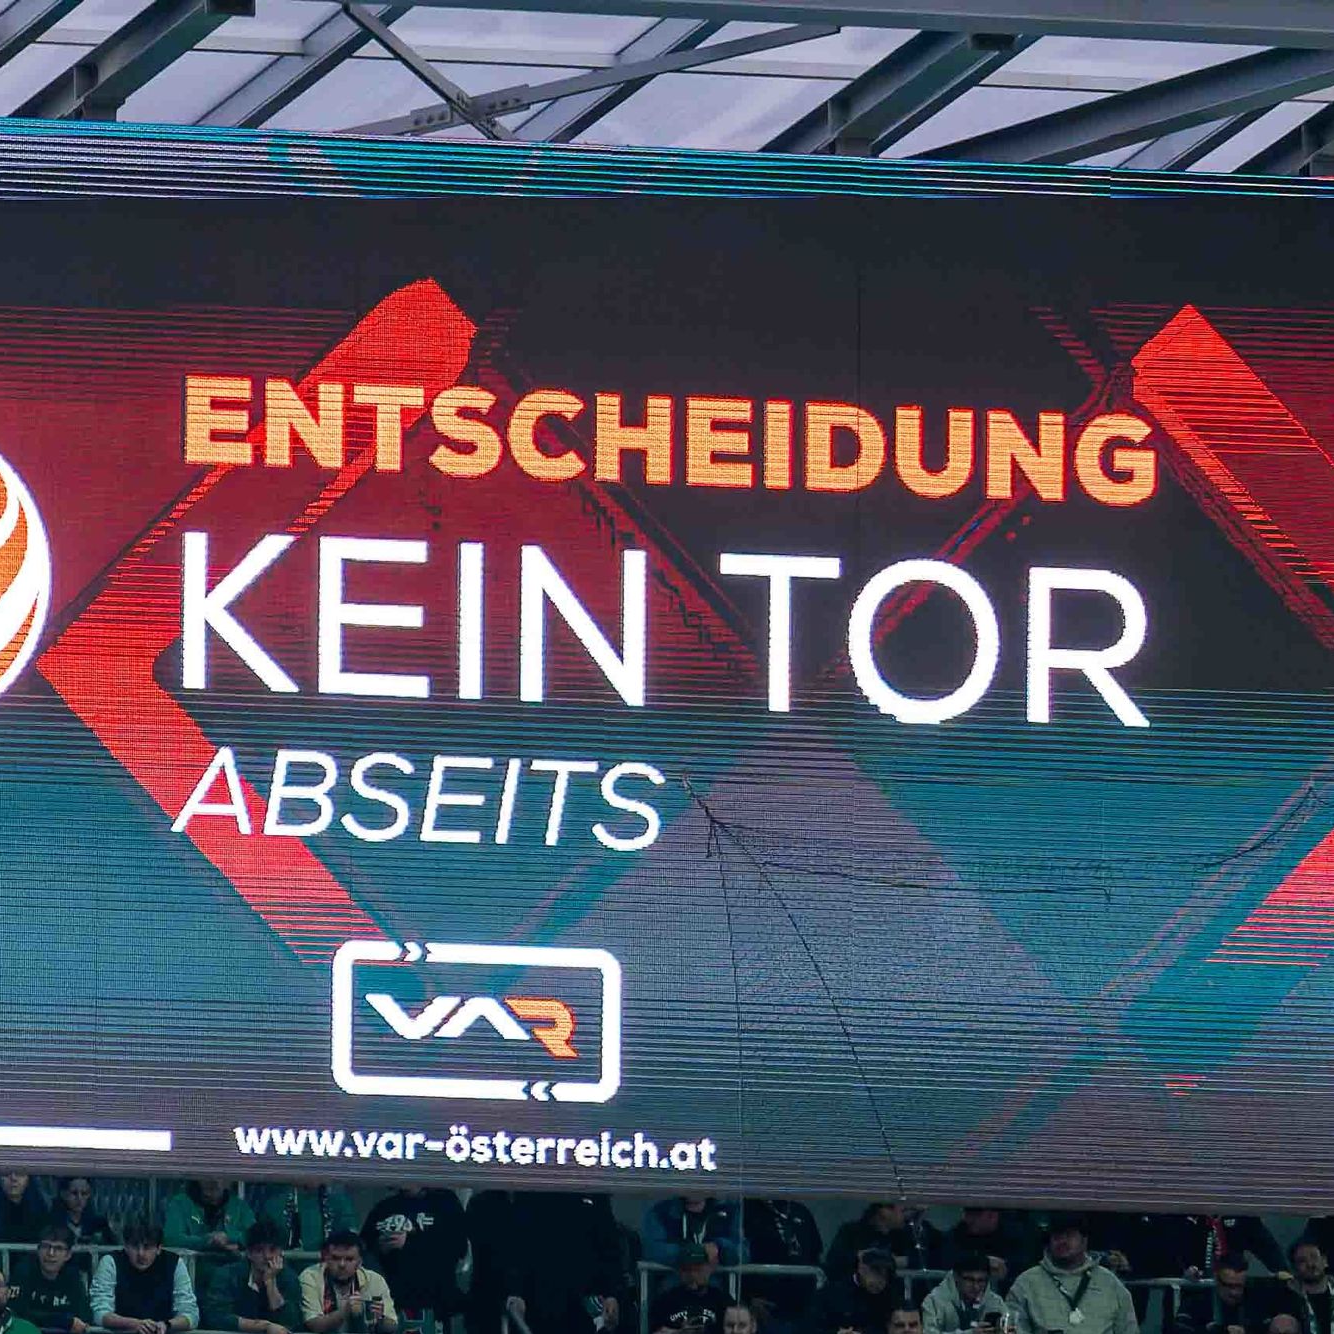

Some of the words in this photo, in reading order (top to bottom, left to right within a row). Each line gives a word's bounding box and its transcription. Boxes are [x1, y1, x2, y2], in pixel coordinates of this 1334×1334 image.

[183, 376, 1157, 506] ENTSCHEIDUNG
[180, 530, 648, 708] KEIN
[717, 552, 1152, 729] TOR
[170, 745, 666, 852] ABSEITS
[365, 993, 579, 1059] VAR
[232, 1124, 717, 1174] www.var-österreich.at
